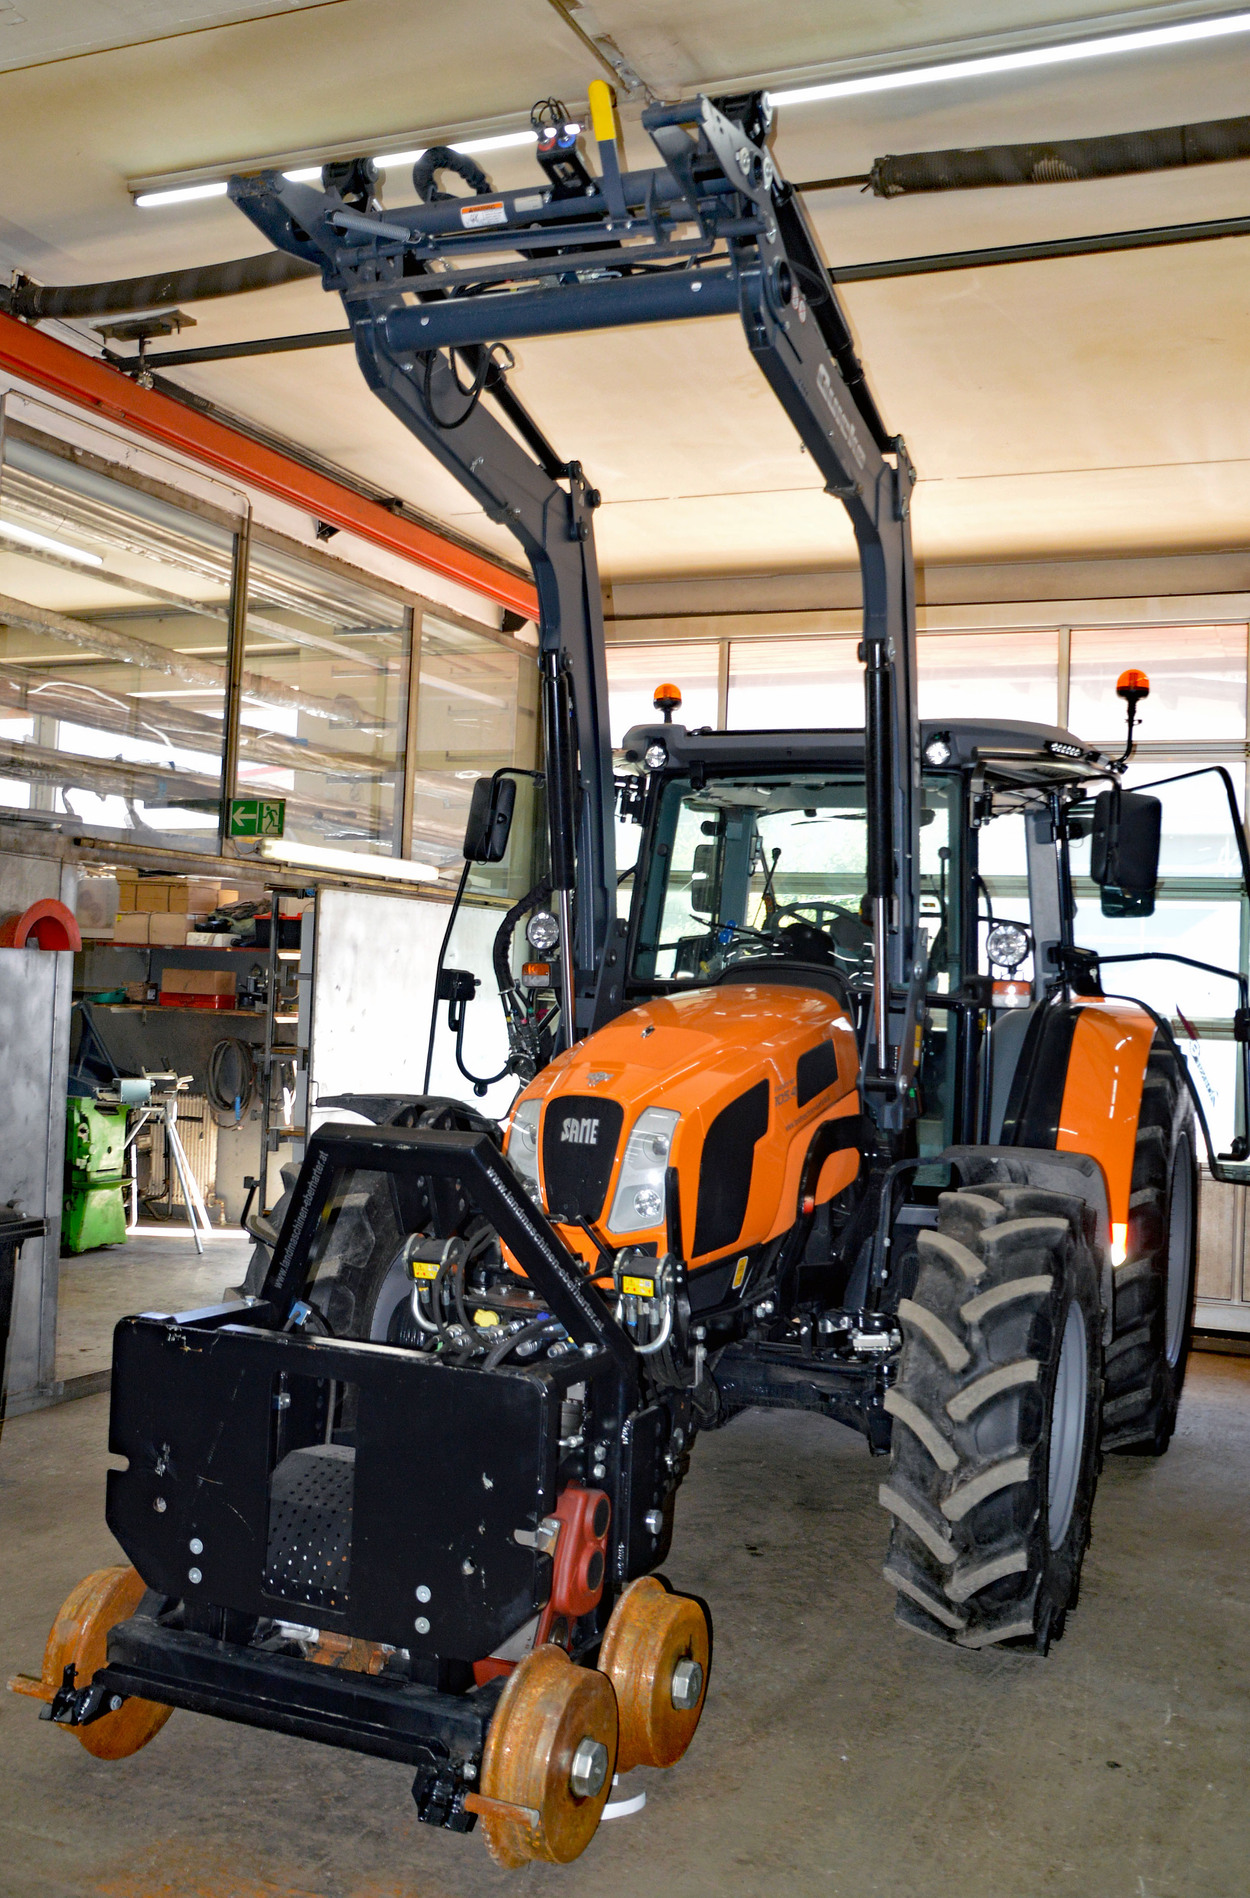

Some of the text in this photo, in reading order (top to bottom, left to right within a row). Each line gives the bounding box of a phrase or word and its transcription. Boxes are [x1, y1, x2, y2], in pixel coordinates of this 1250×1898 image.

[560, 1117, 600, 1145] SAME
[274, 1150, 329, 1290] www.landmaschinen-eberharter.at
[486, 1165, 605, 1332] www.landmaschinen-eberharter.at
